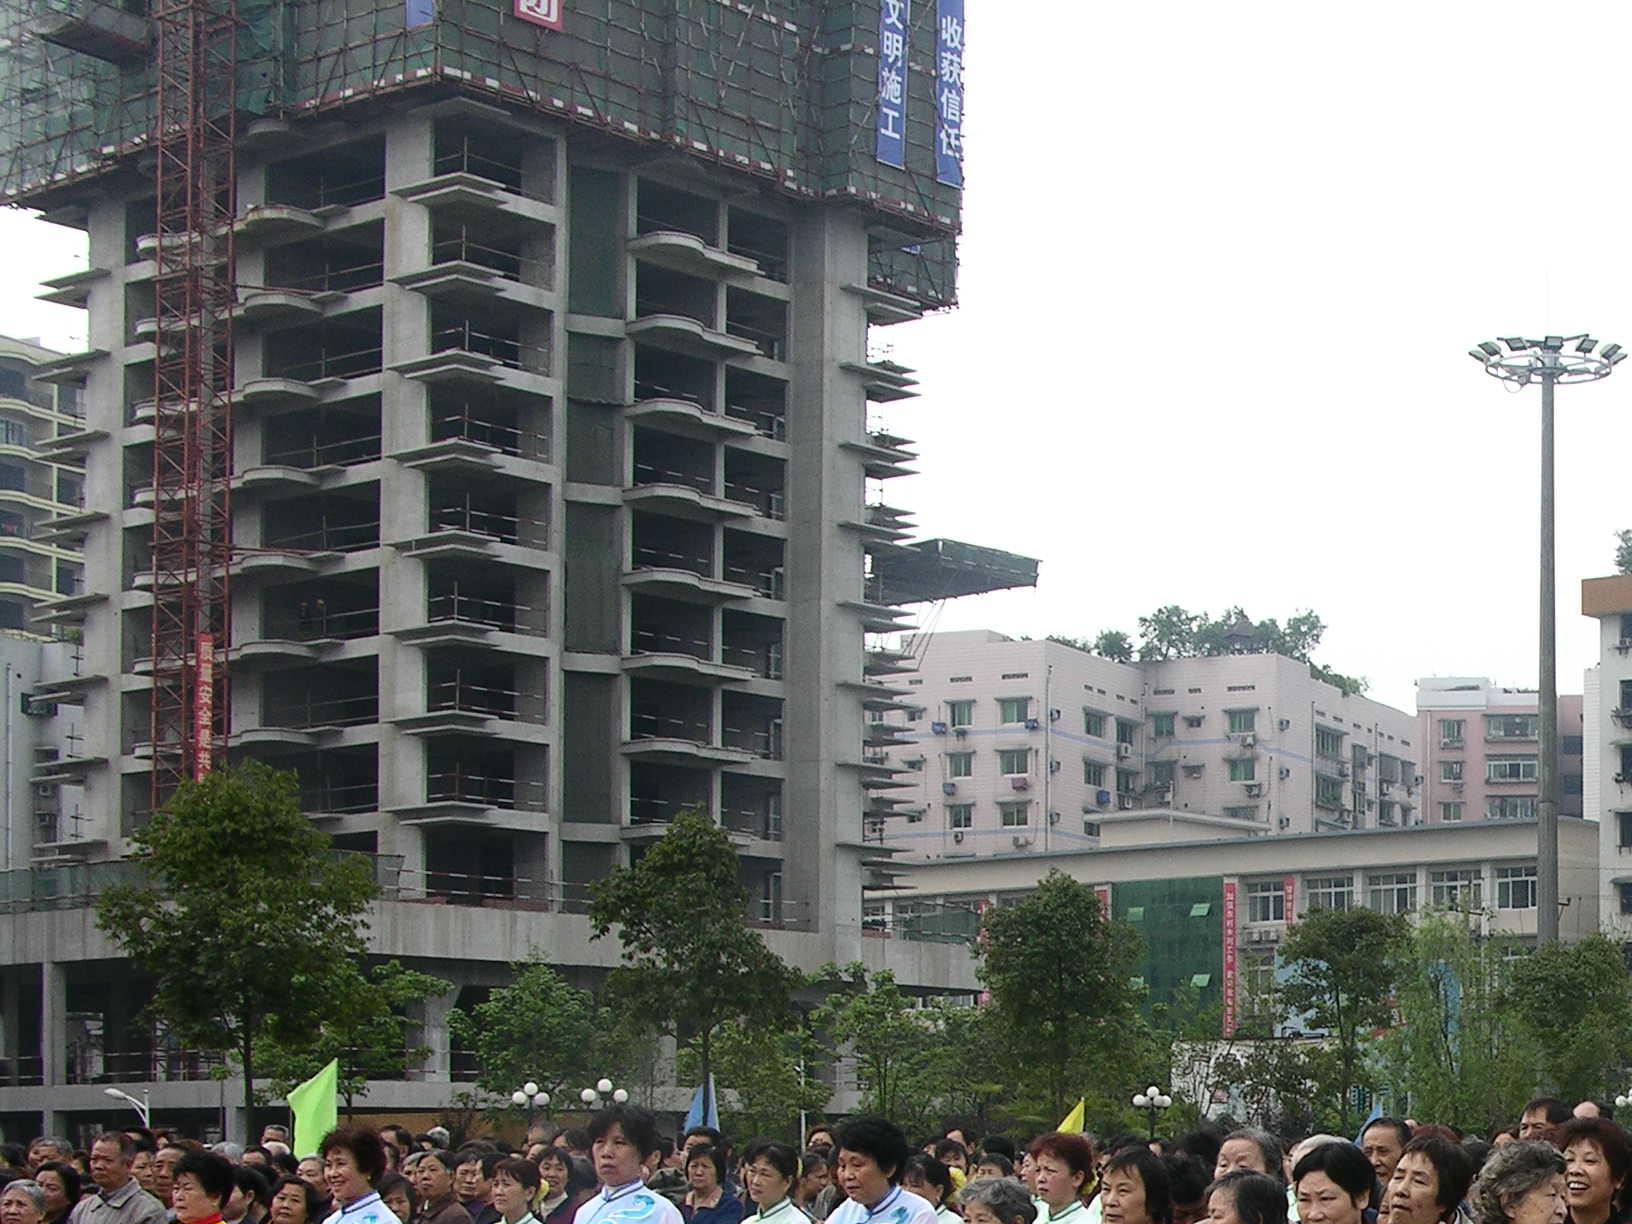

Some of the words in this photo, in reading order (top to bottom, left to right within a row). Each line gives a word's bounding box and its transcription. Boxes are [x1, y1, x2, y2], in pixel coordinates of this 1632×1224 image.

[880, 0, 904, 140] 文明施工
[939, 15, 962, 159] 收获信任
